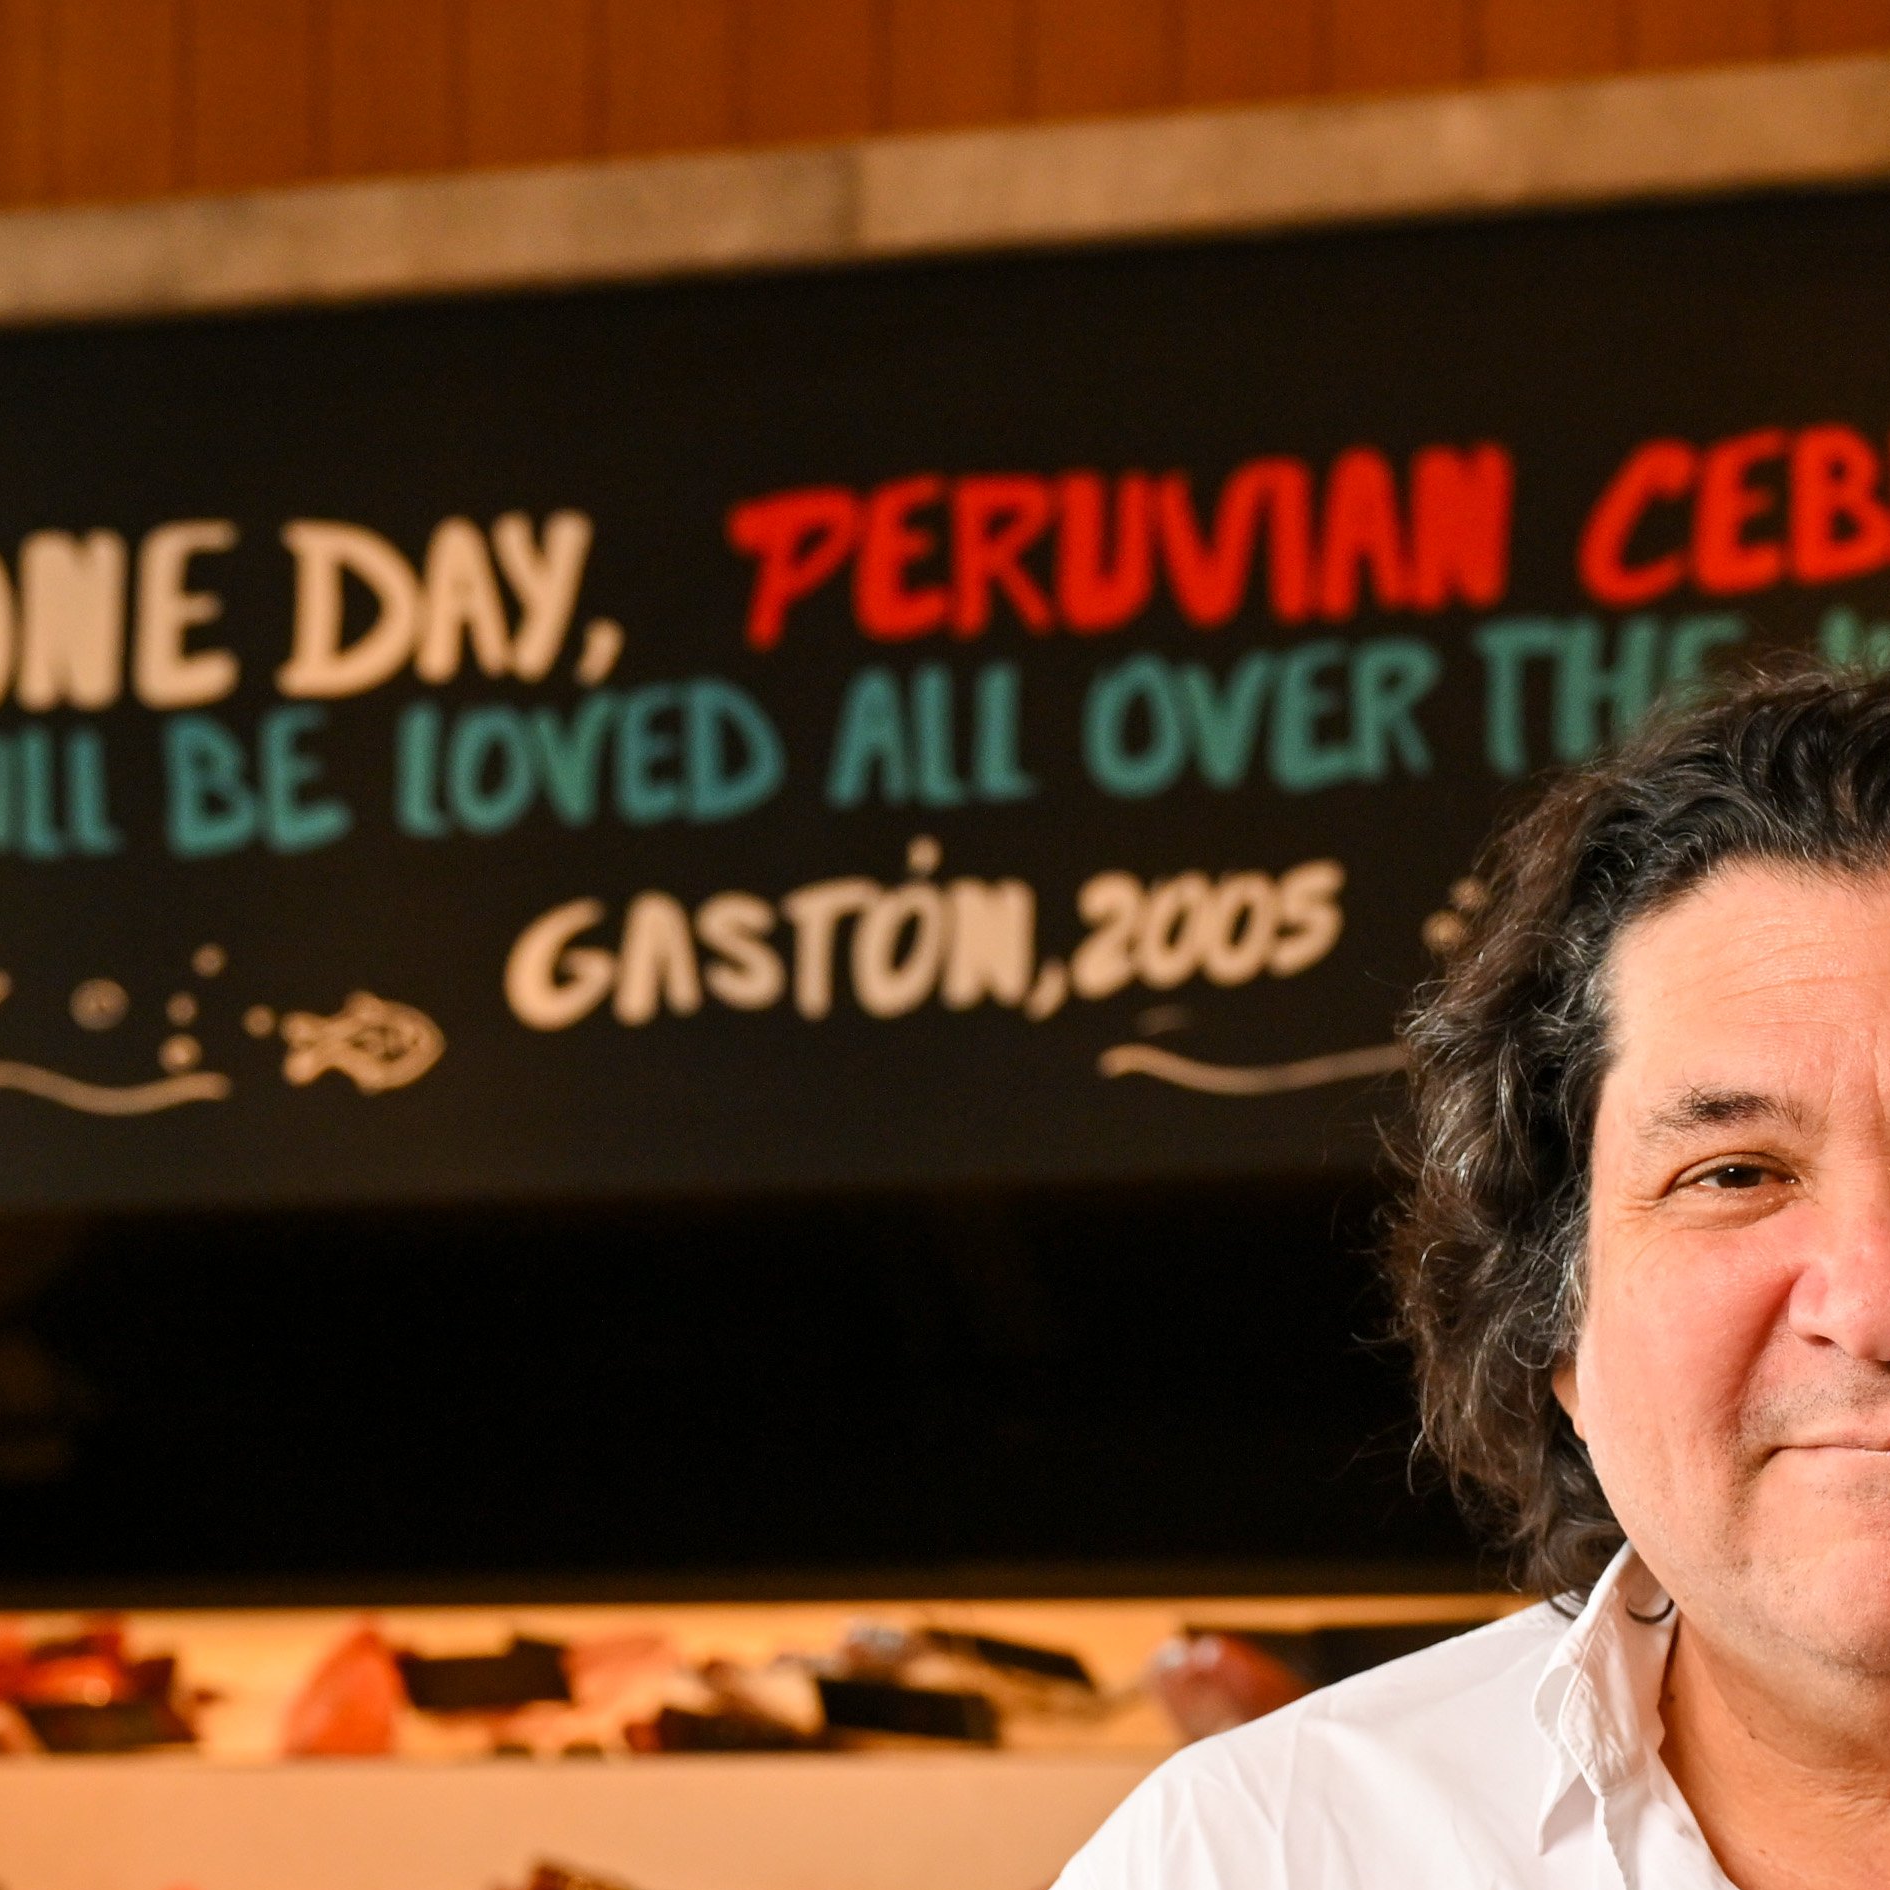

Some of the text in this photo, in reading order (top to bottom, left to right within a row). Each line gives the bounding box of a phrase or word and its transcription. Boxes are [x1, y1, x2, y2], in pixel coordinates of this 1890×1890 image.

[277, 509, 624, 698] DAY,
[726, 442, 1513, 648] PERUVIAN
[165, 706, 353, 855] BE
[396, 678, 783, 838] LOVED
[827, 660, 1036, 805] ALL
[1083, 640, 1442, 796] OVER
